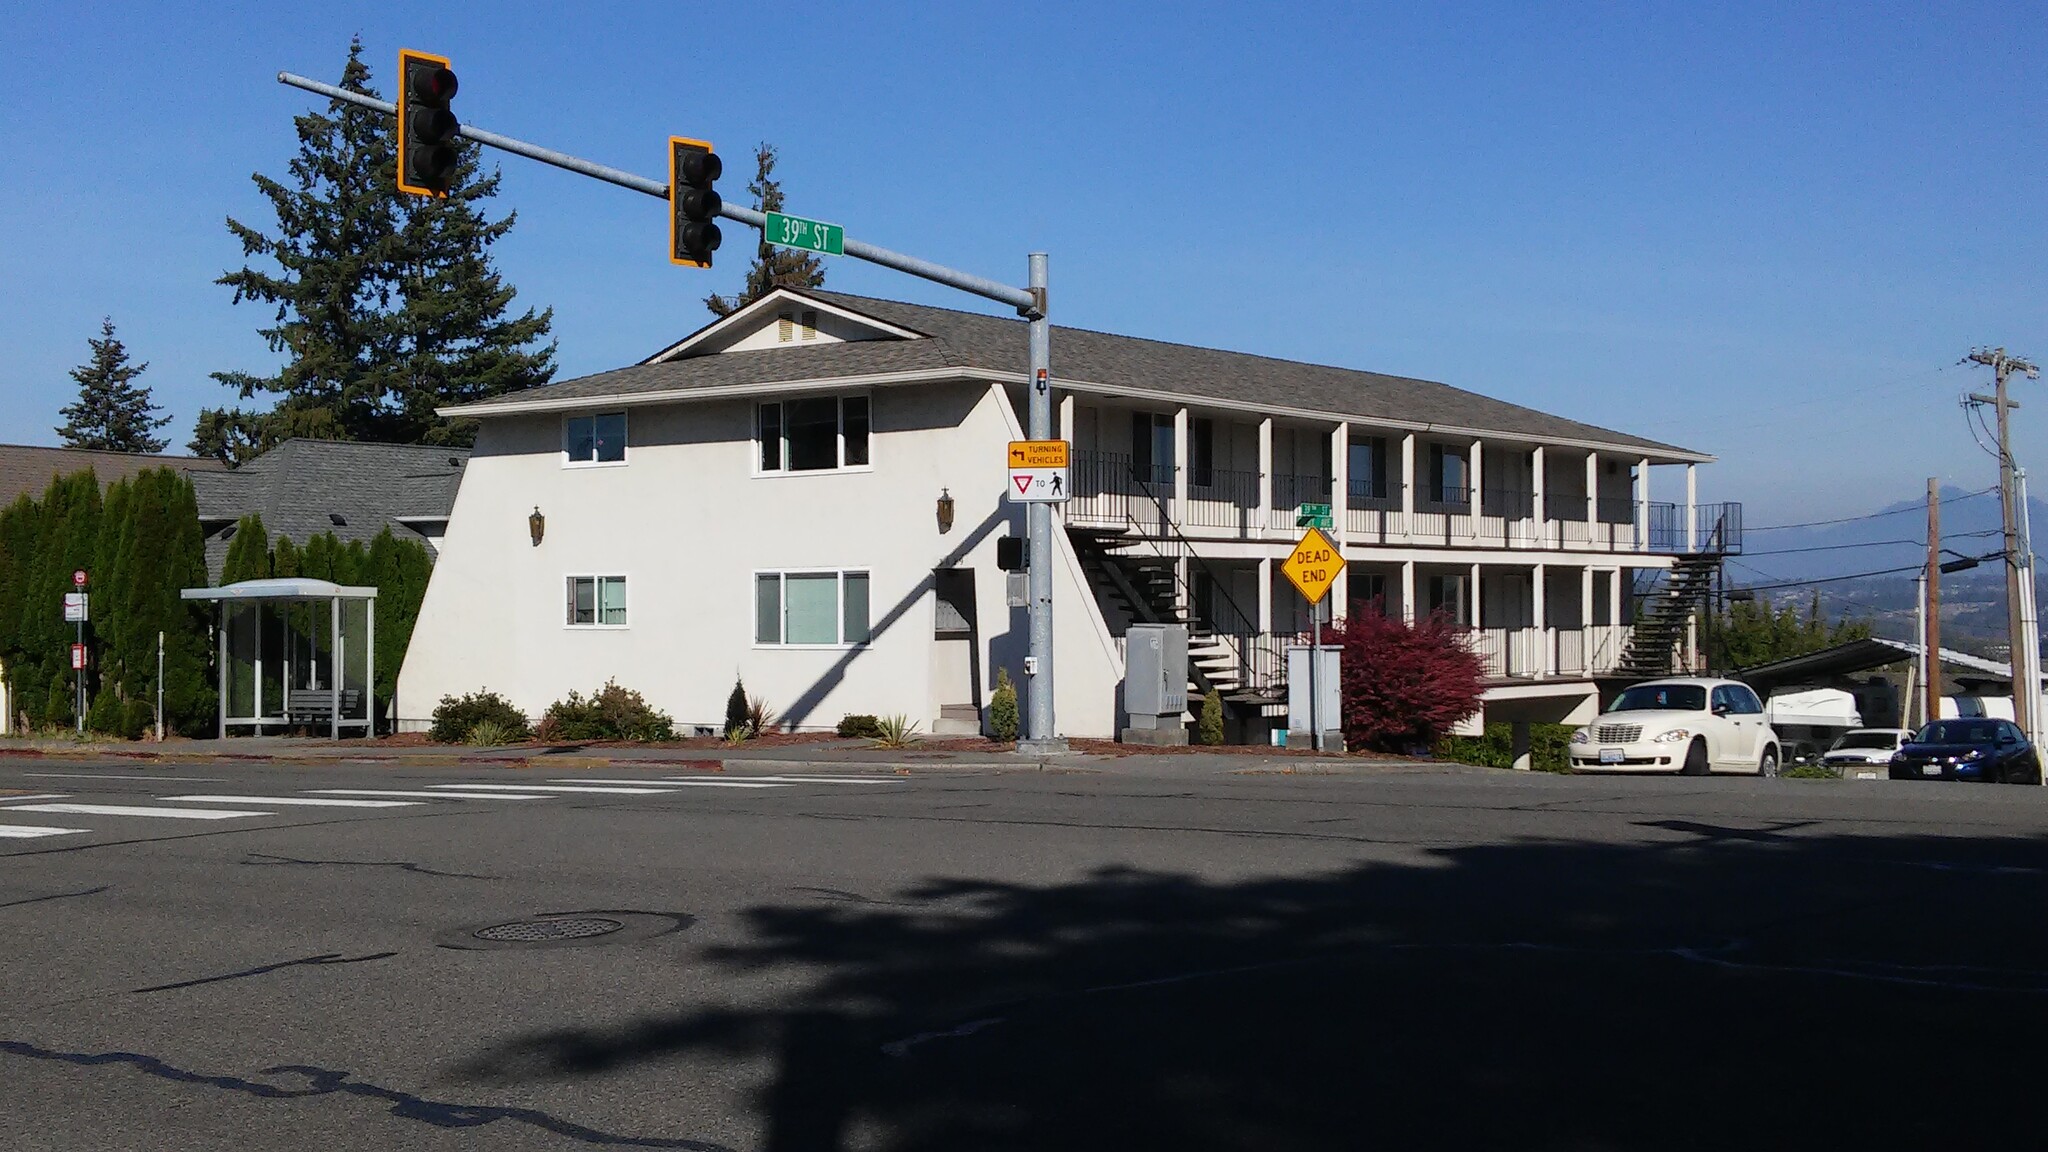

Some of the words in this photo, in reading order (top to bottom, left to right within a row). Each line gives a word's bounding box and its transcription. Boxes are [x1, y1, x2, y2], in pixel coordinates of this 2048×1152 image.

[781, 218, 808, 244] 39TH
[813, 224, 830, 250] ST
[1028, 445, 1062, 453] TURNING
[1027, 456, 1064, 464] VEHICLES
[1036, 480, 1046, 488] TO
[1297, 549, 1330, 564] DEAD
[1302, 569, 1327, 583] END
